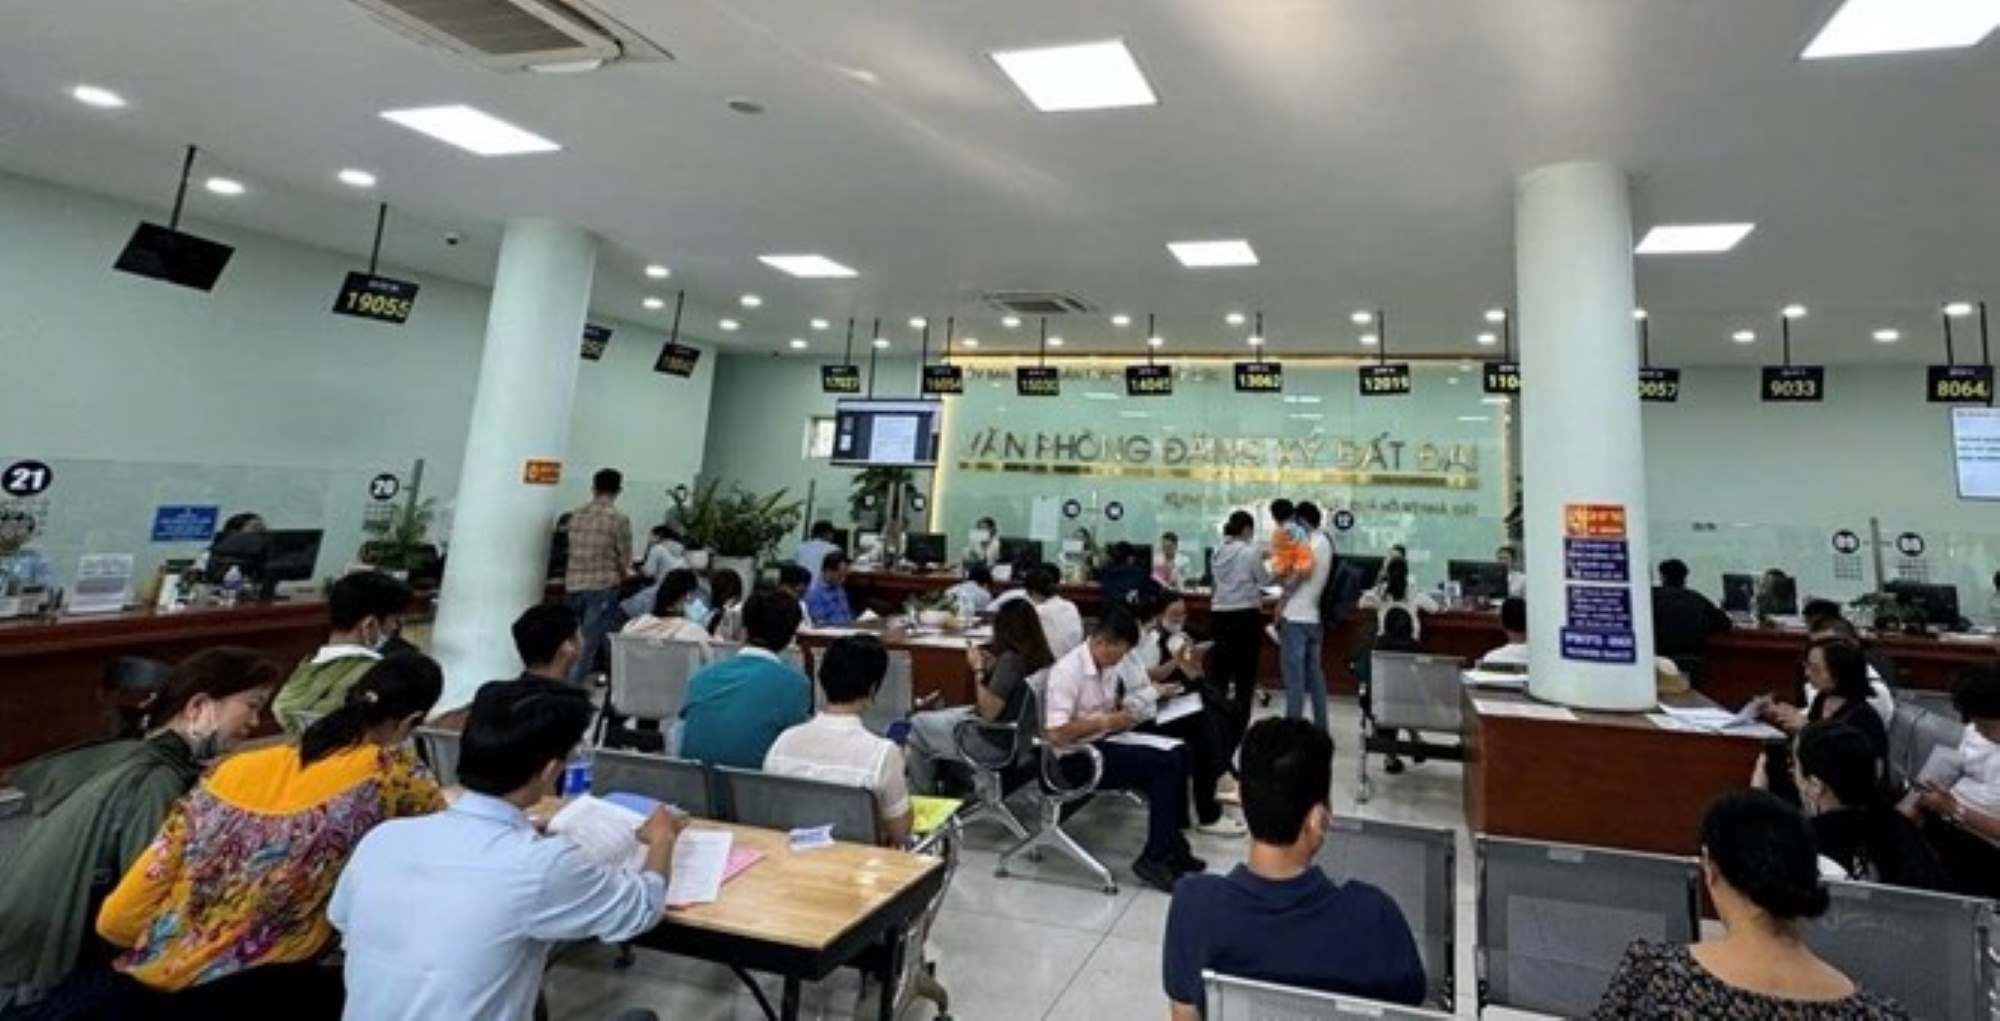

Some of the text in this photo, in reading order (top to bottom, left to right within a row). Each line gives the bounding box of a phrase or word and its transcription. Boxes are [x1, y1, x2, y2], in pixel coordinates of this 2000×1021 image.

[346, 292, 412, 318] 19055
[1771, 379, 1816, 396] 9033
[1937, 380, 1988, 397] 8064
[969, 428, 1026, 459] VĂN
[1035, 429, 1151, 463] PHÒNG
[9, 468, 45, 491] 21
[373, 479, 395, 495] 20
